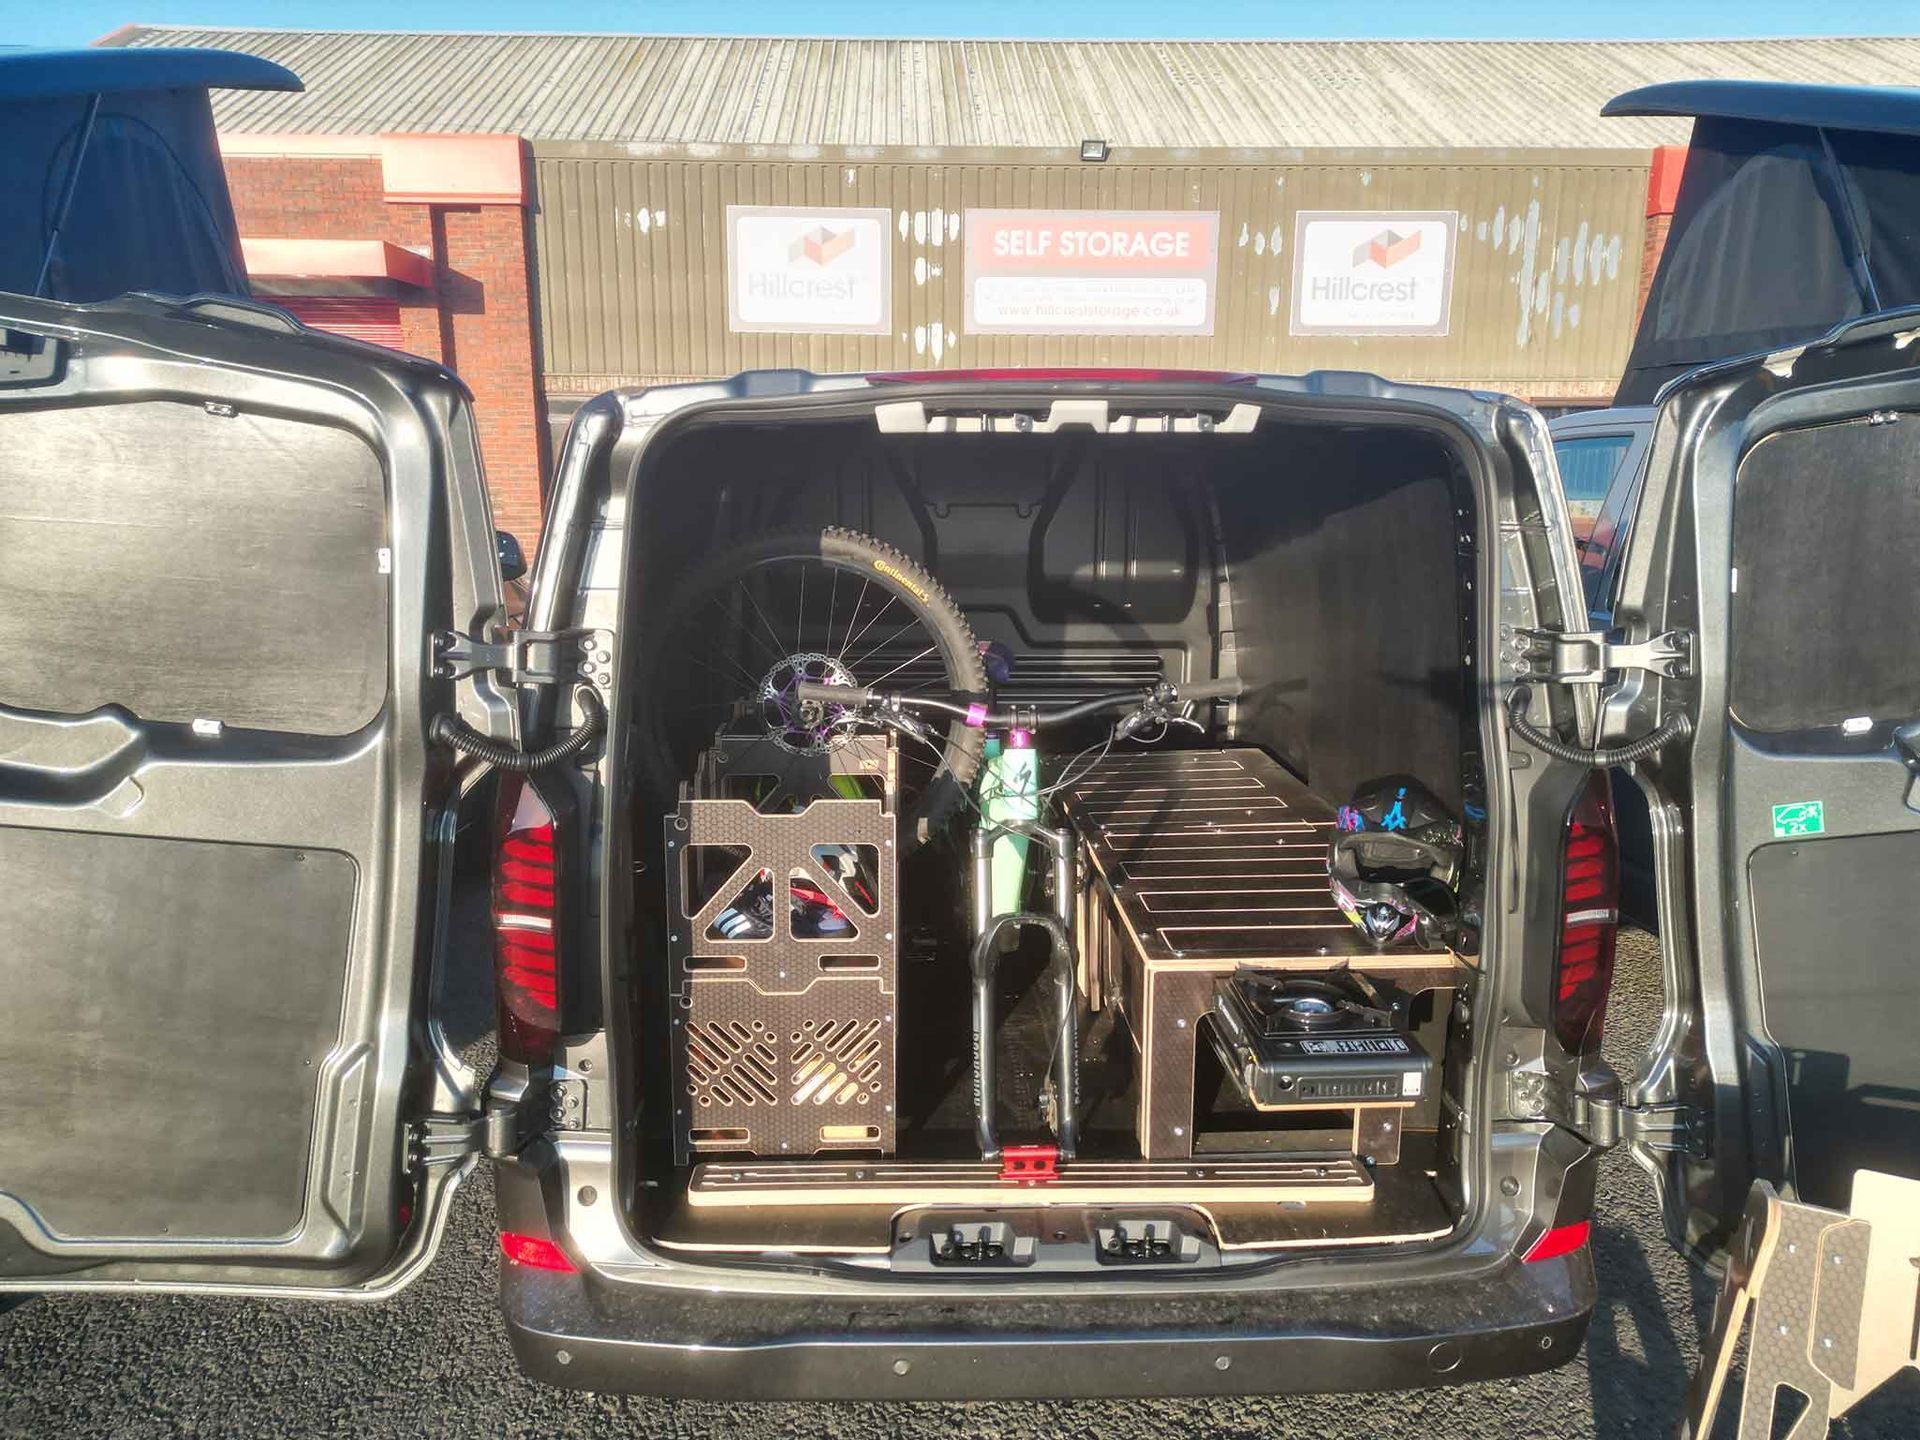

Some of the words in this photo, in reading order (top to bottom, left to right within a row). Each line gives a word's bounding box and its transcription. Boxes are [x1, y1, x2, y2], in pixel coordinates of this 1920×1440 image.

[993, 229, 1052, 257] SELF
[1059, 230, 1190, 258] STORAGE
[749, 271, 857, 300] Hillcrest
[1311, 275, 1418, 302] Hillcrest
[873, 559, 925, 598] Continental
